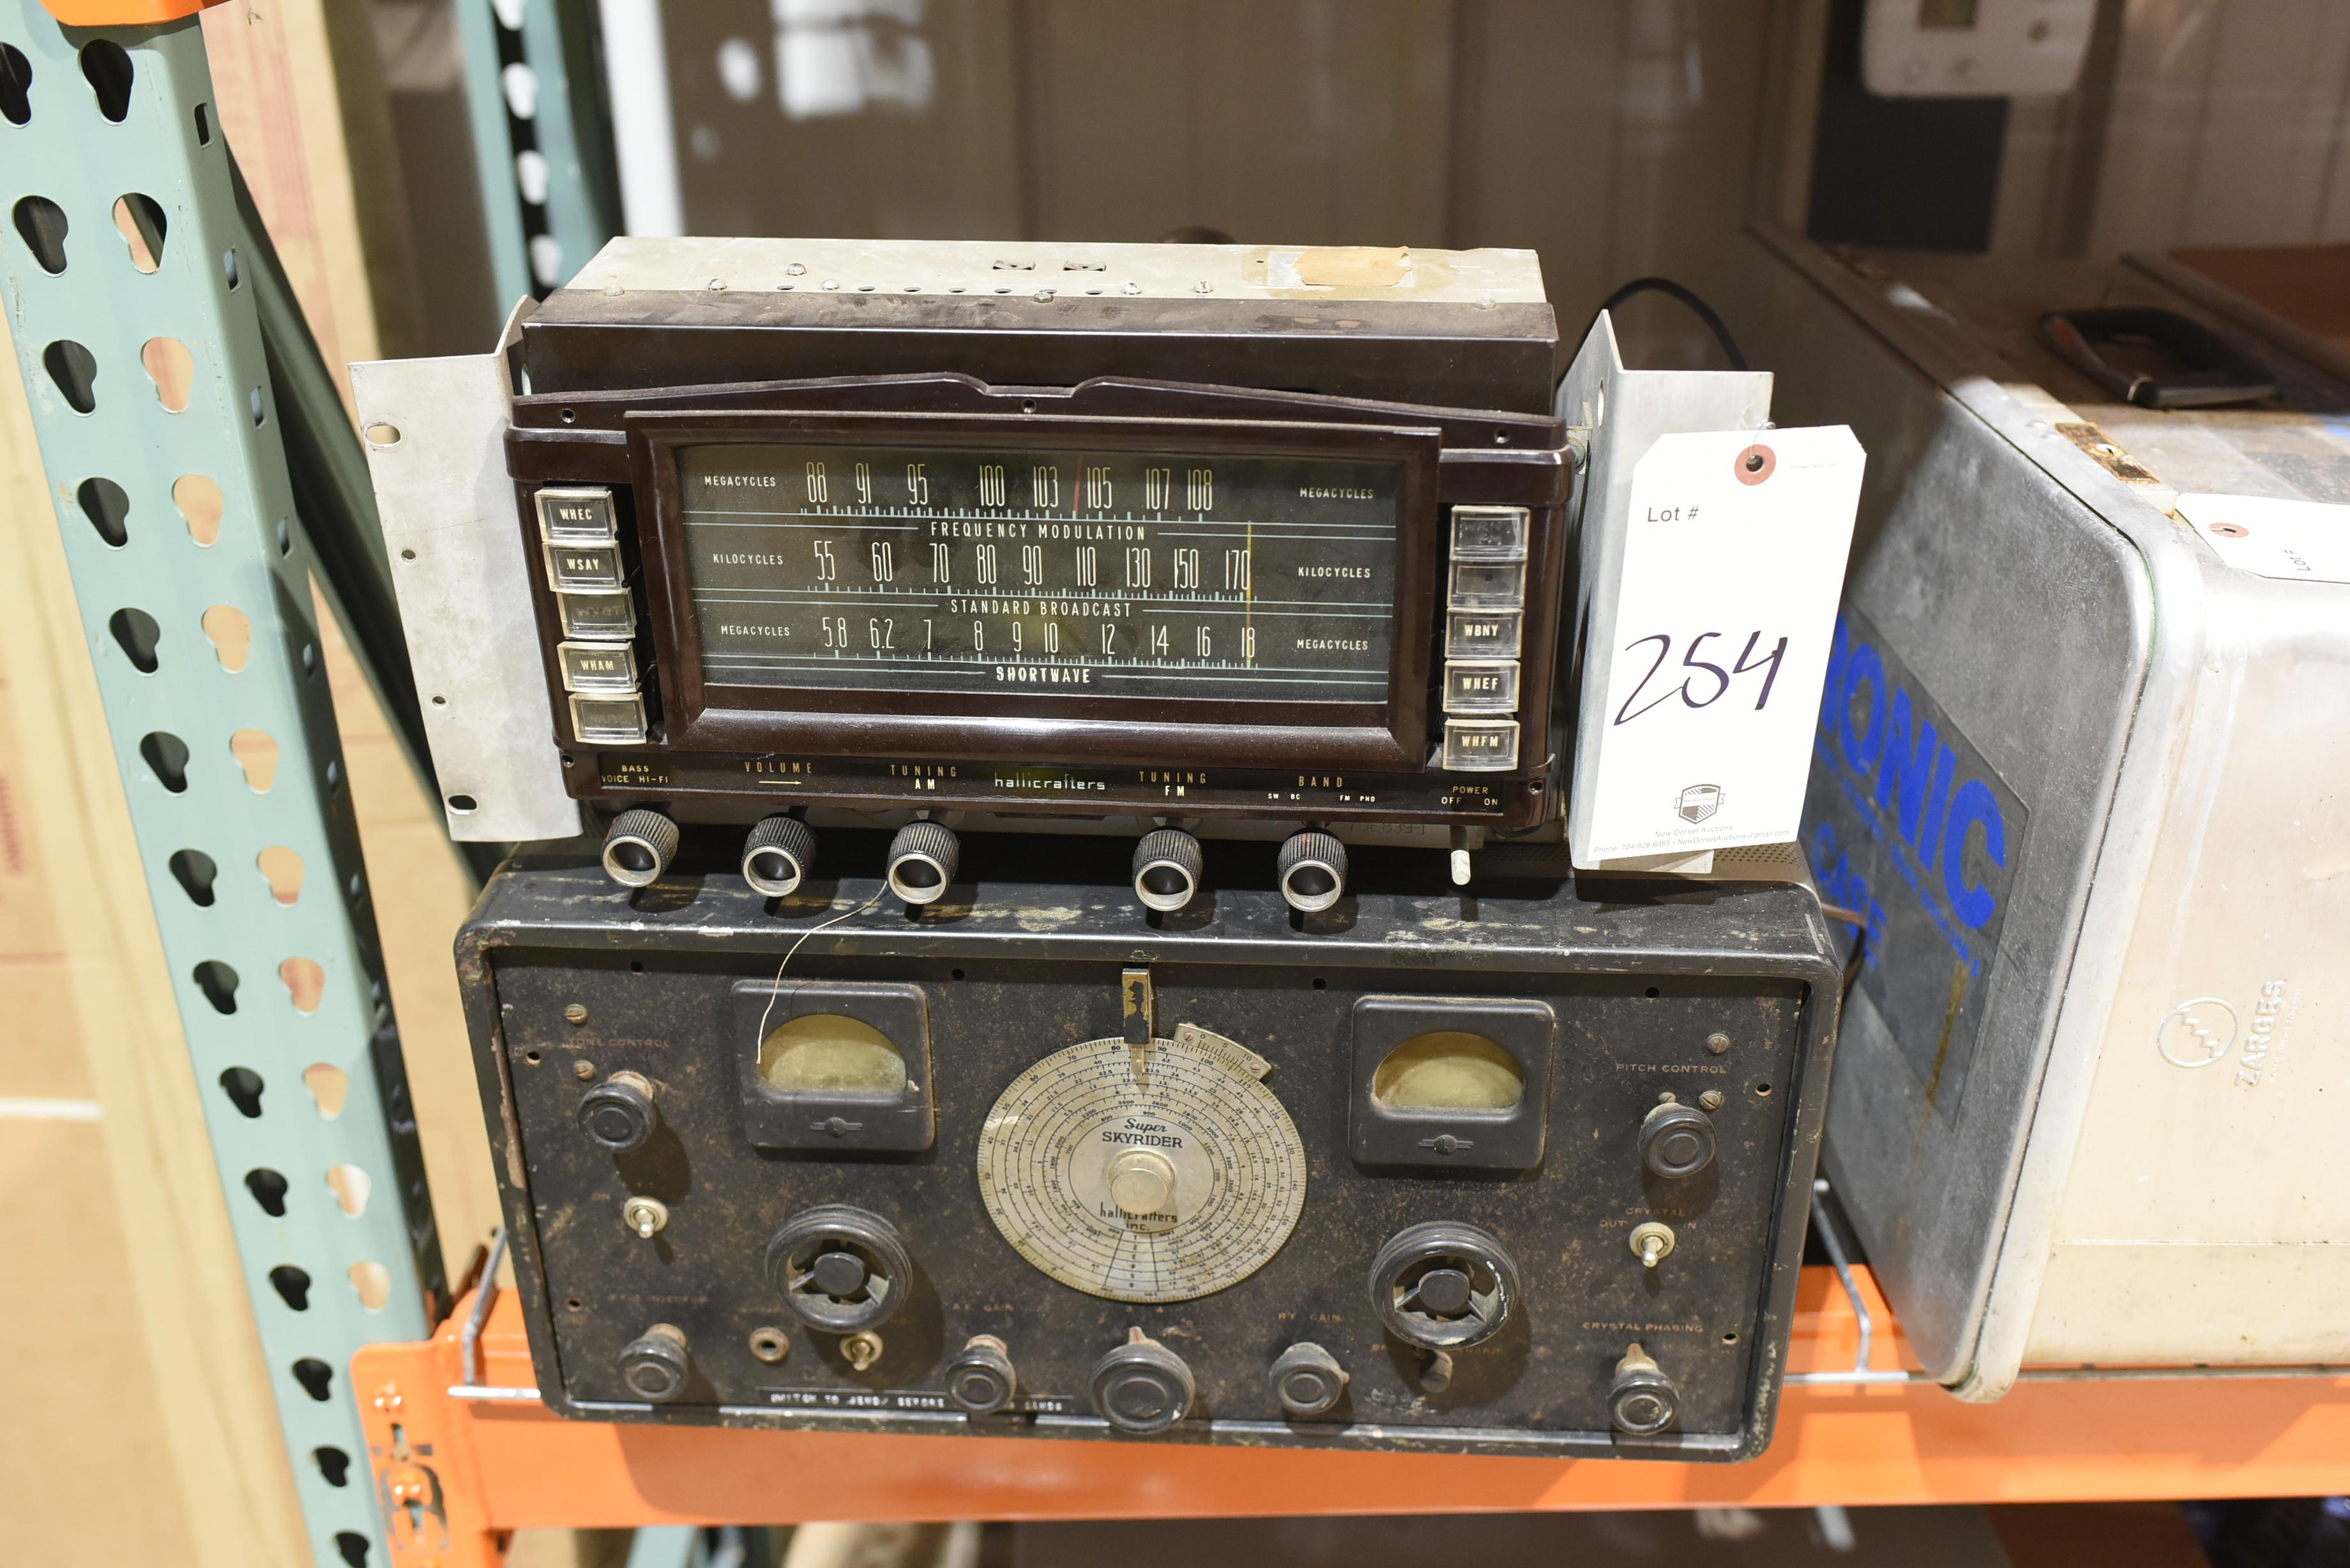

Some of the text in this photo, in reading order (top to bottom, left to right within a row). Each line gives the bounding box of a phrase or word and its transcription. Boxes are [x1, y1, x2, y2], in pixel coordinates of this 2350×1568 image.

[704, 462, 1374, 511] MEGACYCLES 88 91 95 100 103 105 107 108 MEGACYCLES
[559, 508, 593, 522] WHEC
[1647, 505, 1699, 522] Lot #
[931, 521, 1146, 541] FREQUENCY MODULATION
[566, 557, 599, 571] WSAY
[713, 541, 1371, 591] KILOCYCLES 55 60 70 80 90 110 130 150 170 KILOCYCLES
[2288, 557, 2311, 571] Lot
[951, 599, 1130, 618] STANDARD BROADCAST
[1464, 624, 1499, 637] WBNY
[720, 617, 1368, 658] MEGACYCLES 5.8 6.2 7 8 9 10 12 14 16 18 MEGACYCLES
[580, 659, 614, 671] WHAM
[996, 666, 1091, 684] SHORTWAVE
[1613, 630, 1788, 726] 254
[1462, 677, 1499, 691] WHEF
[1461, 735, 1499, 748] WHFM
[621, 764, 649, 773] BASS
[745, 761, 813, 774] VOLUME
[890, 764, 958, 778] TUNING
[994, 772, 1105, 790] hallicrafters
[1139, 771, 1206, 784] TUNING
[1298, 776, 1343, 788] BAND
[914, 779, 935, 790] AM
[1165, 785, 1185, 797] FM
[1452, 786, 1489, 794] POWER
[1441, 796, 1462, 804] OFF
[1703, 824, 1733, 833] Auctions
[2233, 980, 2287, 1087] ZARGES
[608, 1039, 671, 1048] CONTROL
[1616, 1063, 1727, 1074] PITCH CONTROL
[1002, 1103, 1010, 1111] 50
[1200, 1057, 1214, 1066] 100
[1270, 1109, 1280, 1120] 120
[1287, 1143, 1296, 1155] 130
[1123, 1117, 1168, 1133] Super
[1102, 1131, 1182, 1149] SKYRIDER
[1625, 1207, 1685, 1217] CRYSTAL
[1126, 1220, 1150, 1232] inc.
[1599, 1219, 1697, 1230] OUT IN
[1582, 1322, 1704, 1334] CRYSTAL PHASING
